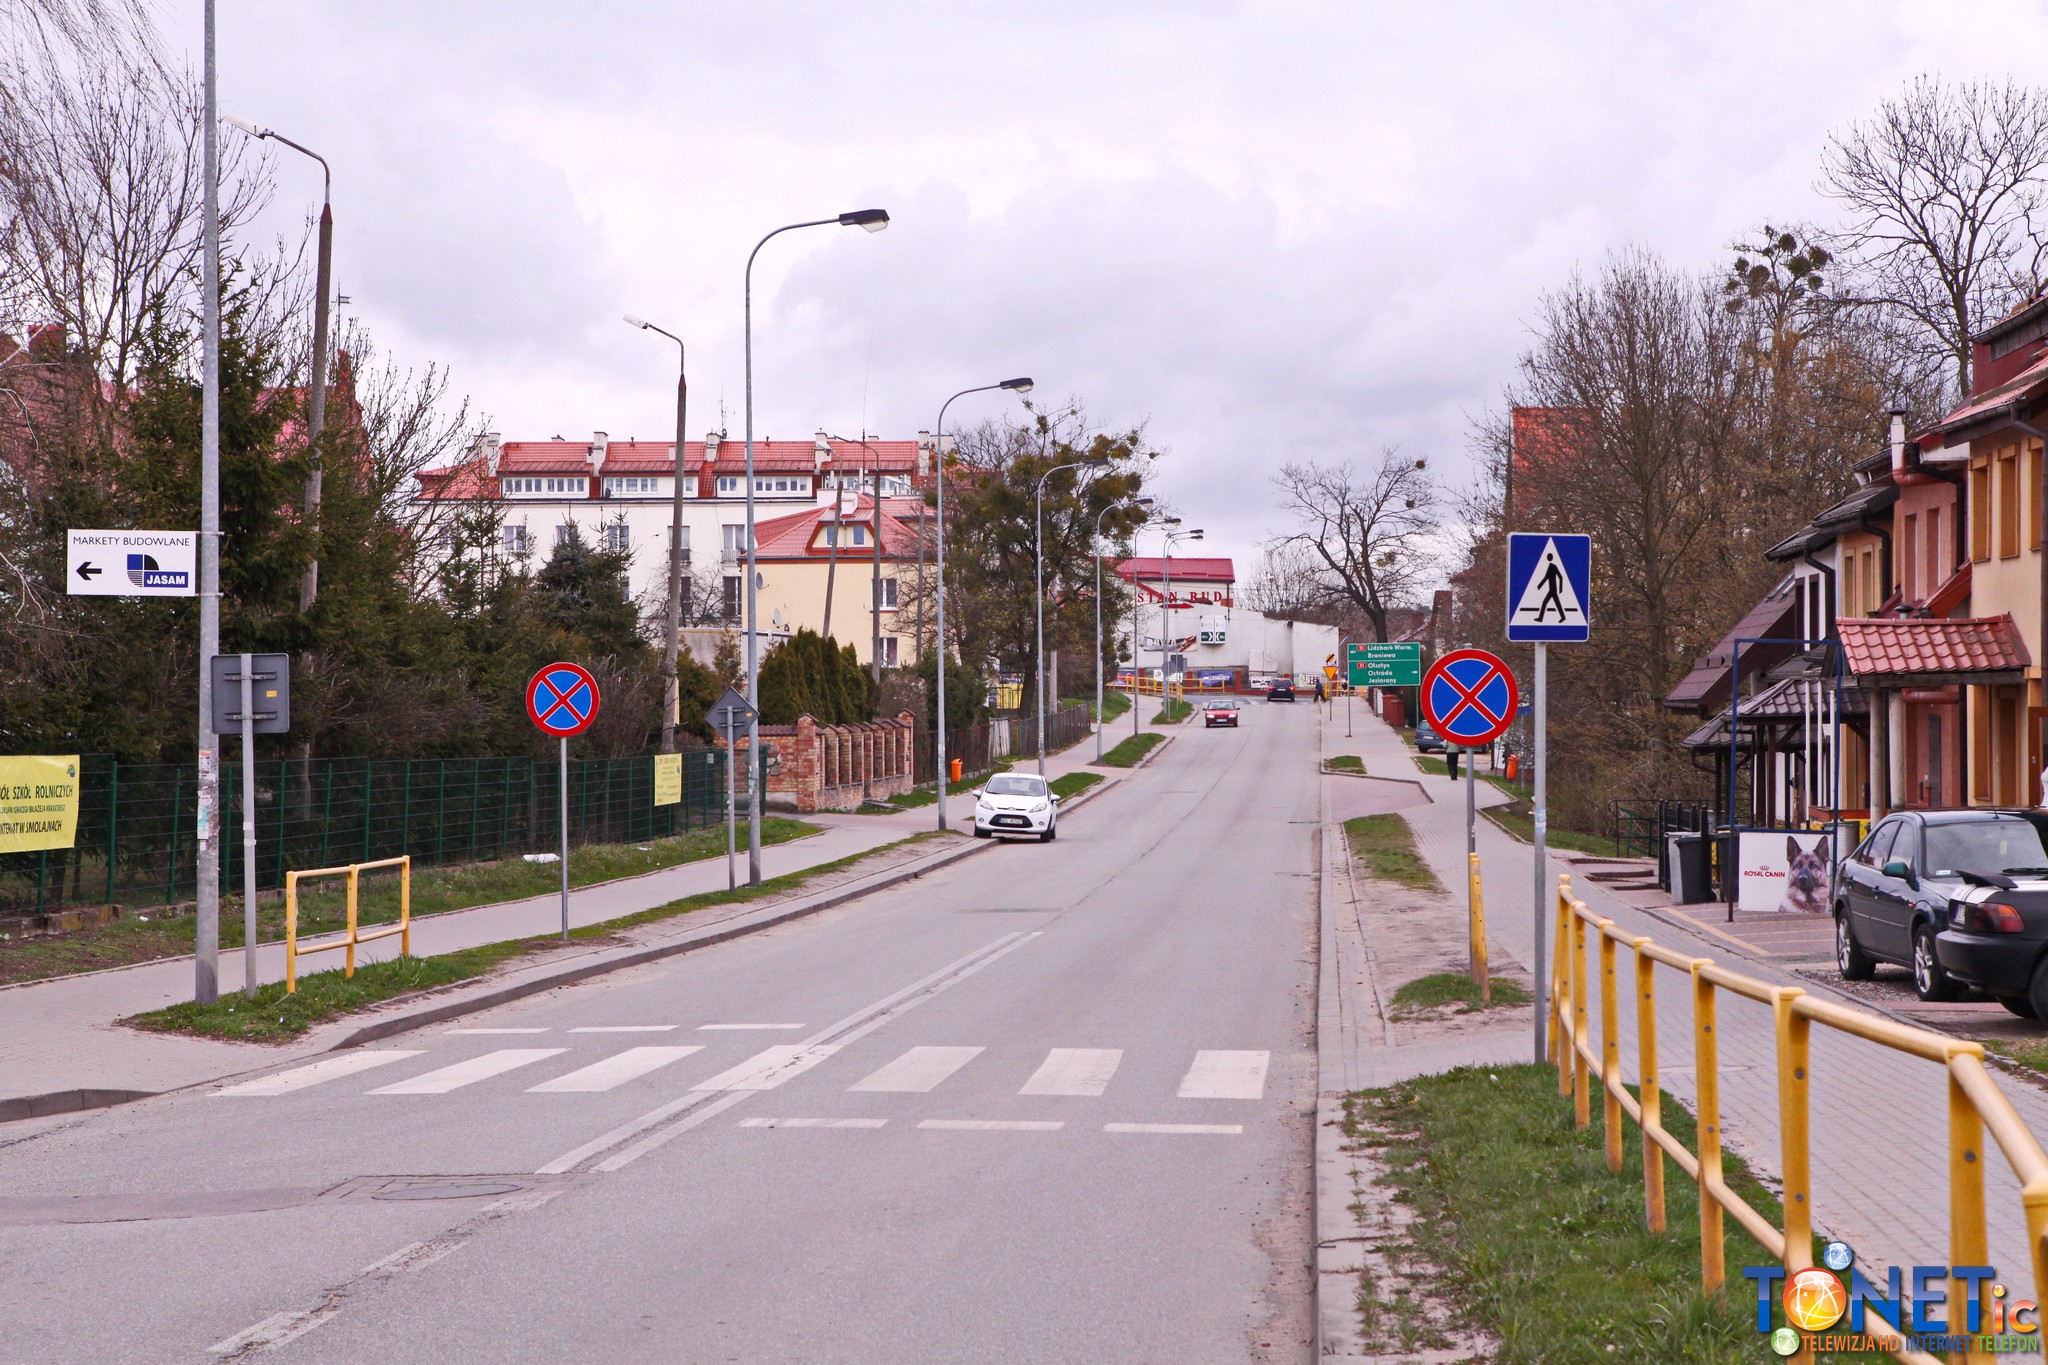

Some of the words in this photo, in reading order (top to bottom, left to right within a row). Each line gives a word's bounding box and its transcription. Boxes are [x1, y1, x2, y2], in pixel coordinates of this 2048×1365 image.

[73, 536, 120, 545] MARKETY
[123, 537, 190, 546] BUDOWLANE
[146, 575, 186, 585] JASAM
[1189, 591, 1222, 603] BUD
[0, 784, 9, 800] ÓŁ
[35, 785, 73, 798] ROLNICZYCH
